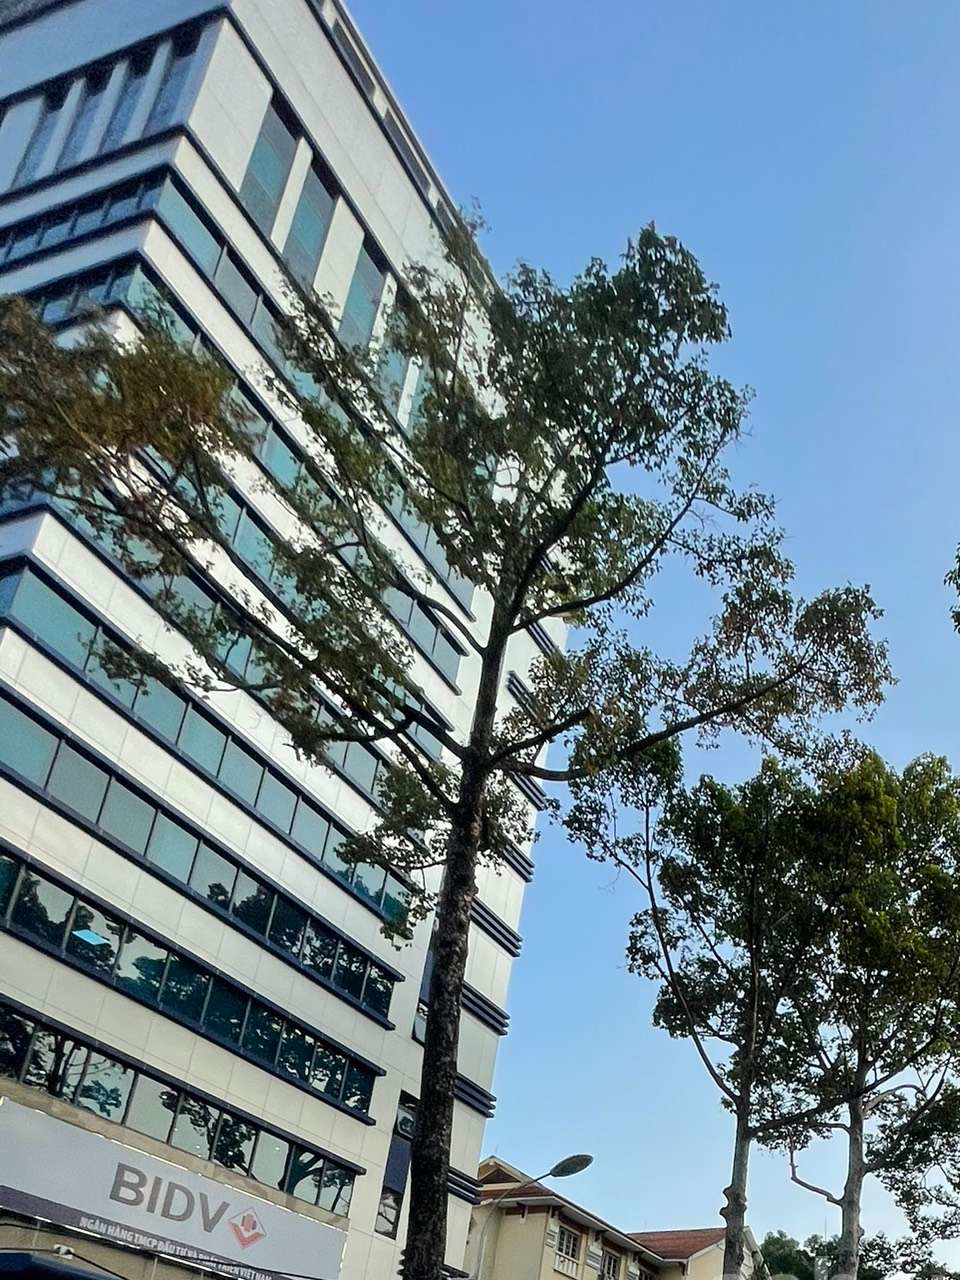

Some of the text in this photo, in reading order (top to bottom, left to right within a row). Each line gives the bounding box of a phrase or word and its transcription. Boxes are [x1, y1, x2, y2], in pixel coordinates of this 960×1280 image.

[109, 1162, 232, 1235] BIDV
[79, 1216, 107, 1234] NGÂN
[107, 1225, 135, 1241] HÀNG
[134, 1233, 158, 1250] TMCP
